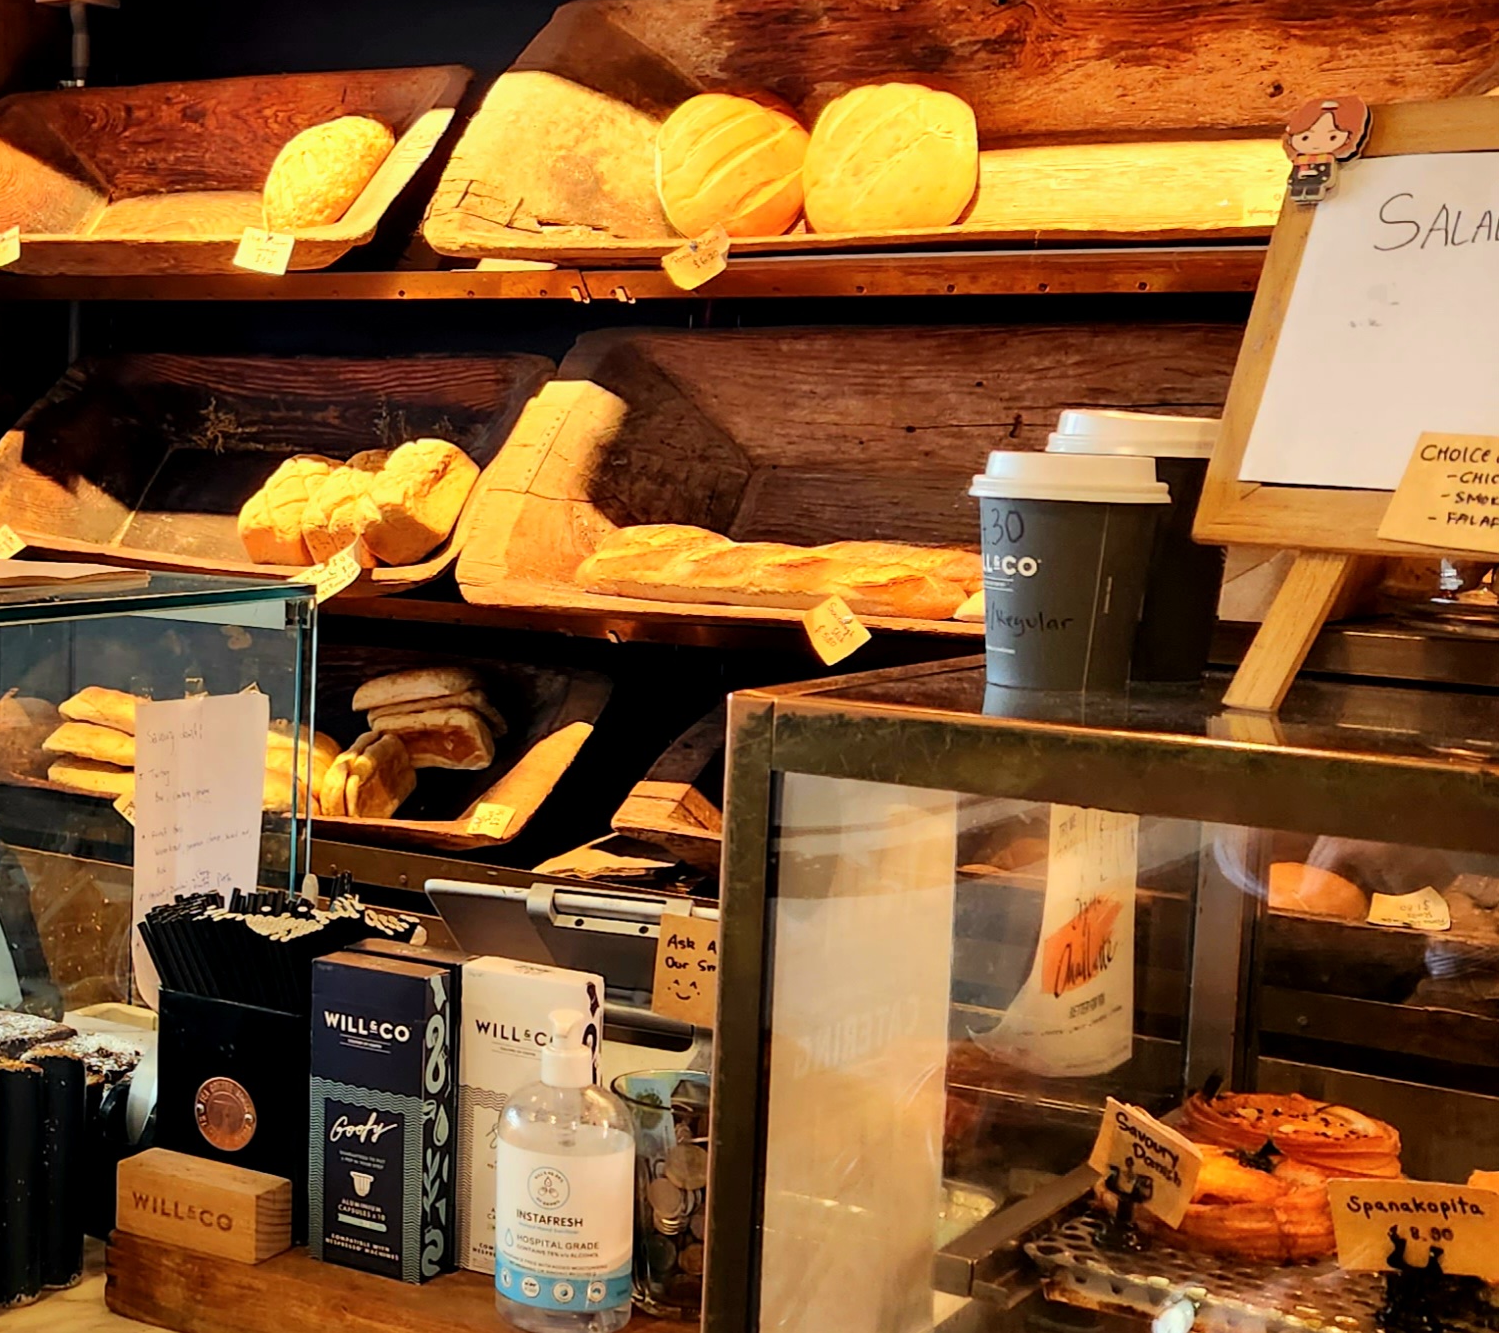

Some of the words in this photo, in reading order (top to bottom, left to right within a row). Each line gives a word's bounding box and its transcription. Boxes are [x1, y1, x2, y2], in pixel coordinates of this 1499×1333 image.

[1373, 192, 1499, 252] SALA
[667, 933, 696, 950] Ask
[665, 956, 690, 970] Our
[323, 1010, 411, 1043] WILL&CO
[475, 1019, 554, 1047] WILL&C
[1115, 1111, 1180, 1170] Savoury
[132, 1190, 234, 1232] WILL&CO
[516, 1208, 584, 1228] INSTAFRESH
[1346, 1194, 1486, 1221] Spanakopita
[516, 1233, 563, 1250] HOSPITAL
[565, 1241, 600, 1251] GRADE
